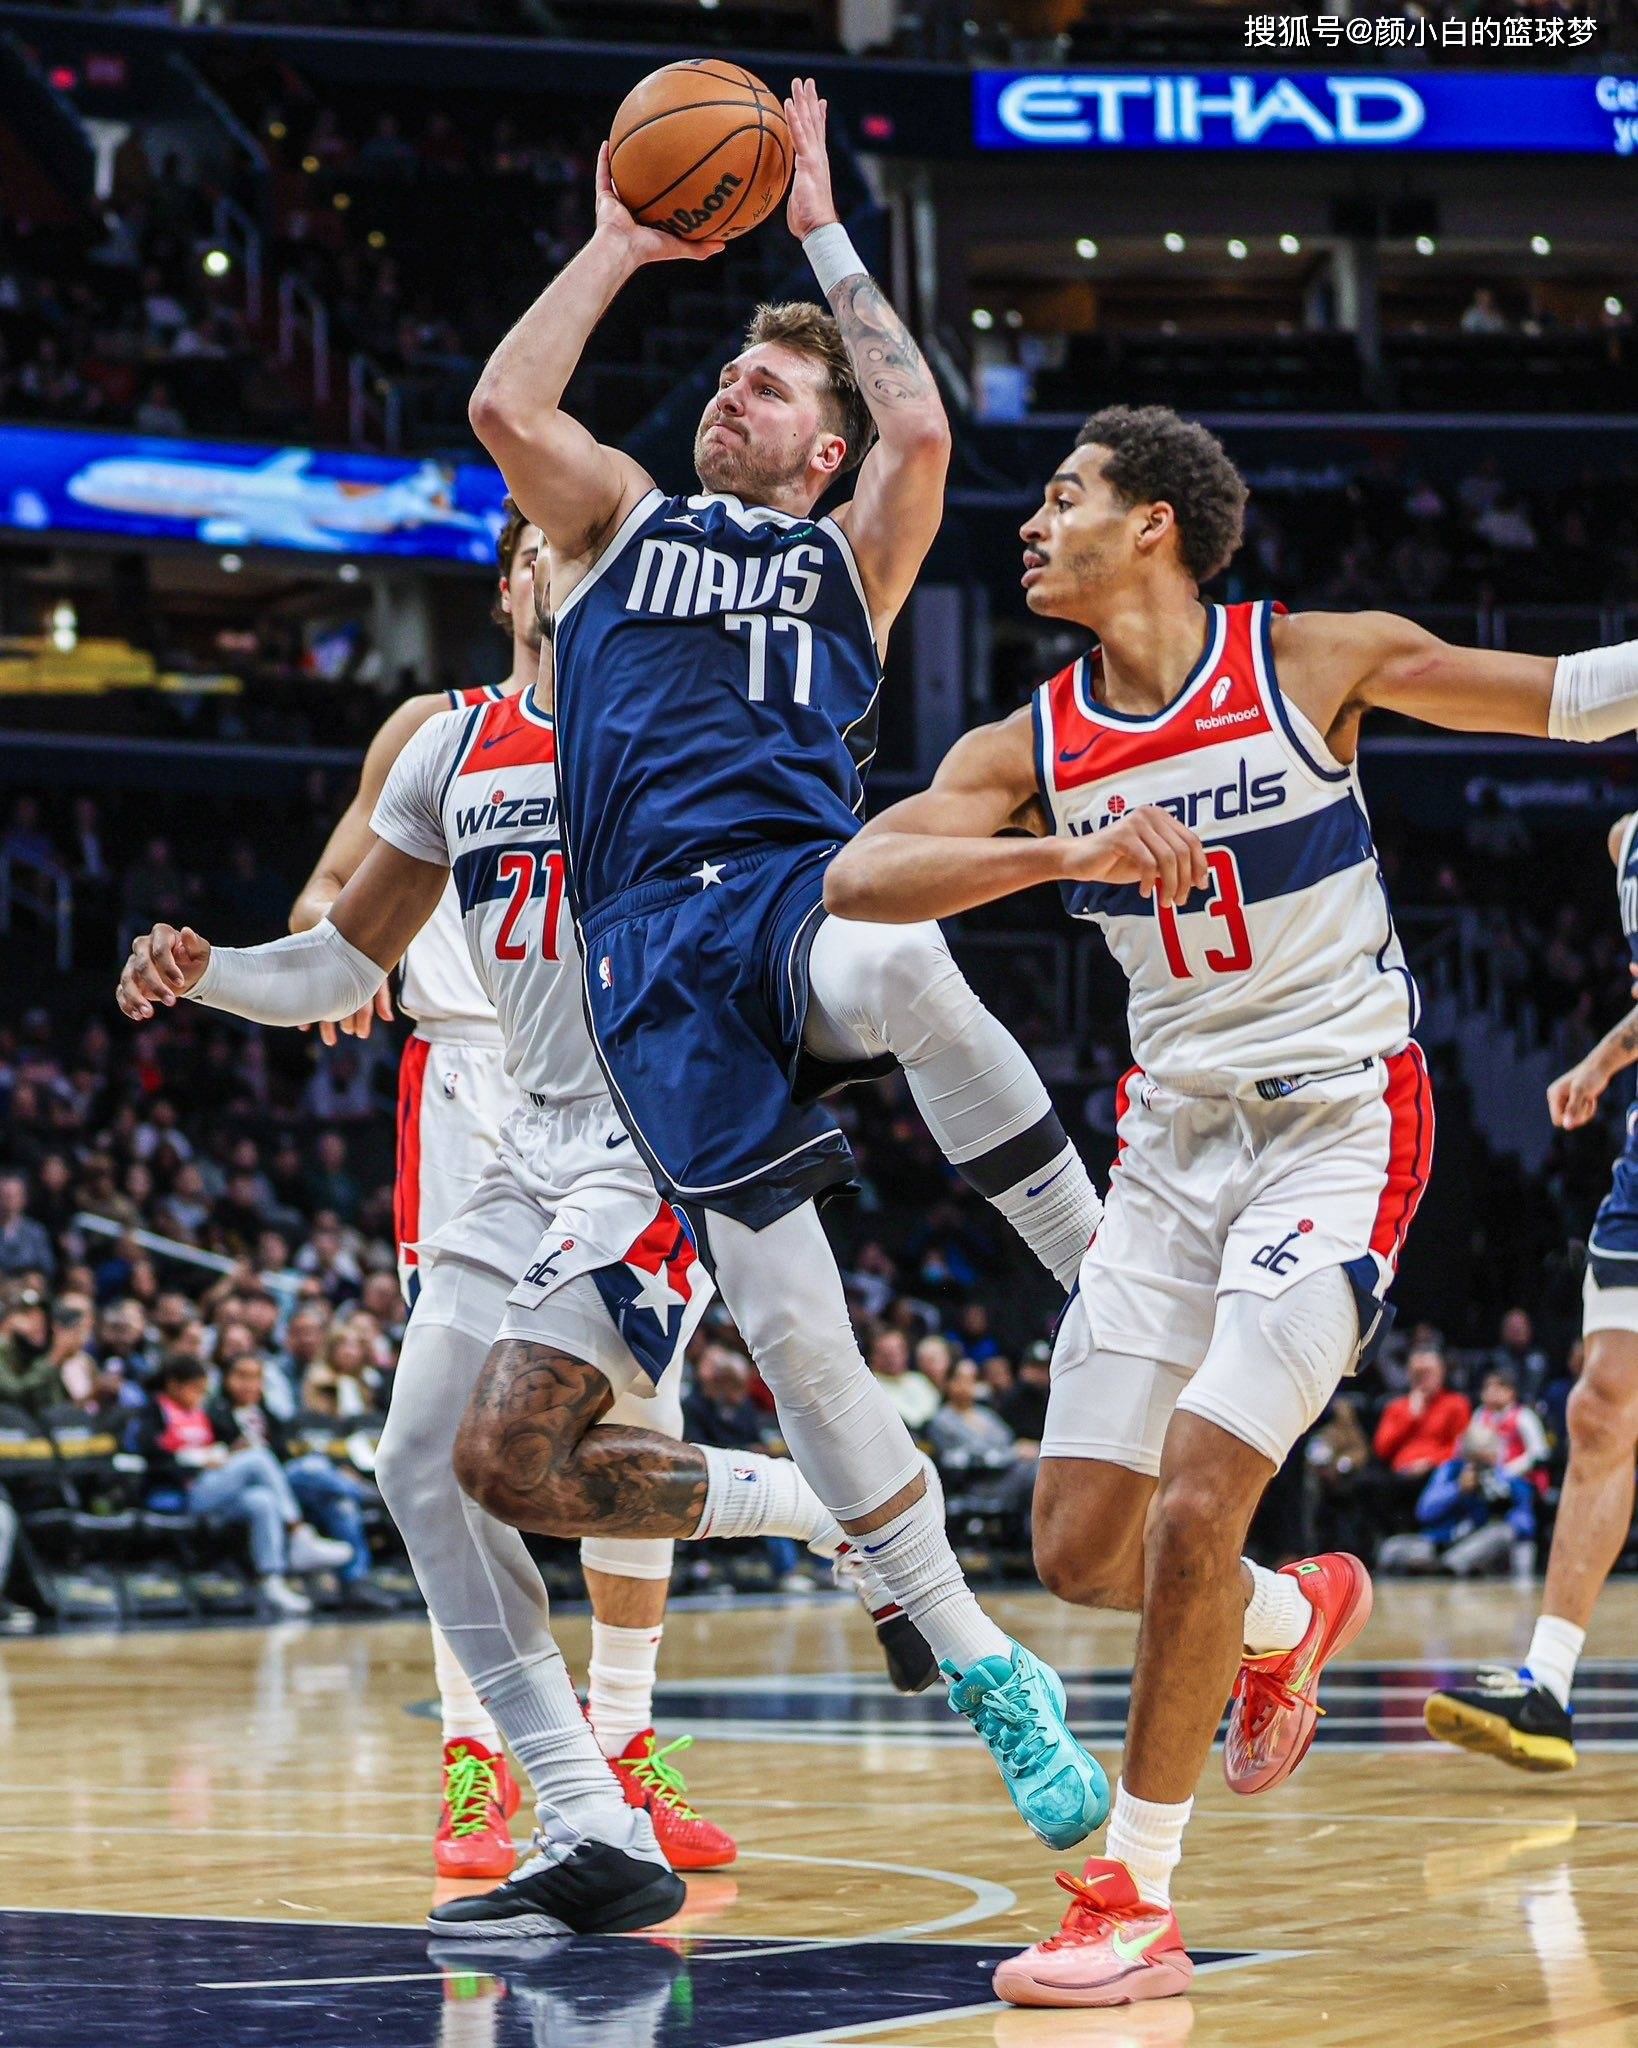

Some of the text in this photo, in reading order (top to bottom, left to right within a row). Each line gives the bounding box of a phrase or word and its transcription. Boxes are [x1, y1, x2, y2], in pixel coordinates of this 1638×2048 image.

[998, 75, 1426, 142] ETIHAD
[625, 538, 824, 617] MAVS
[724, 613, 813, 706] 77
[1194, 704, 1260, 732] Robinhood
[495, 850, 565, 964] 21
[1154, 845, 1254, 979] 13
